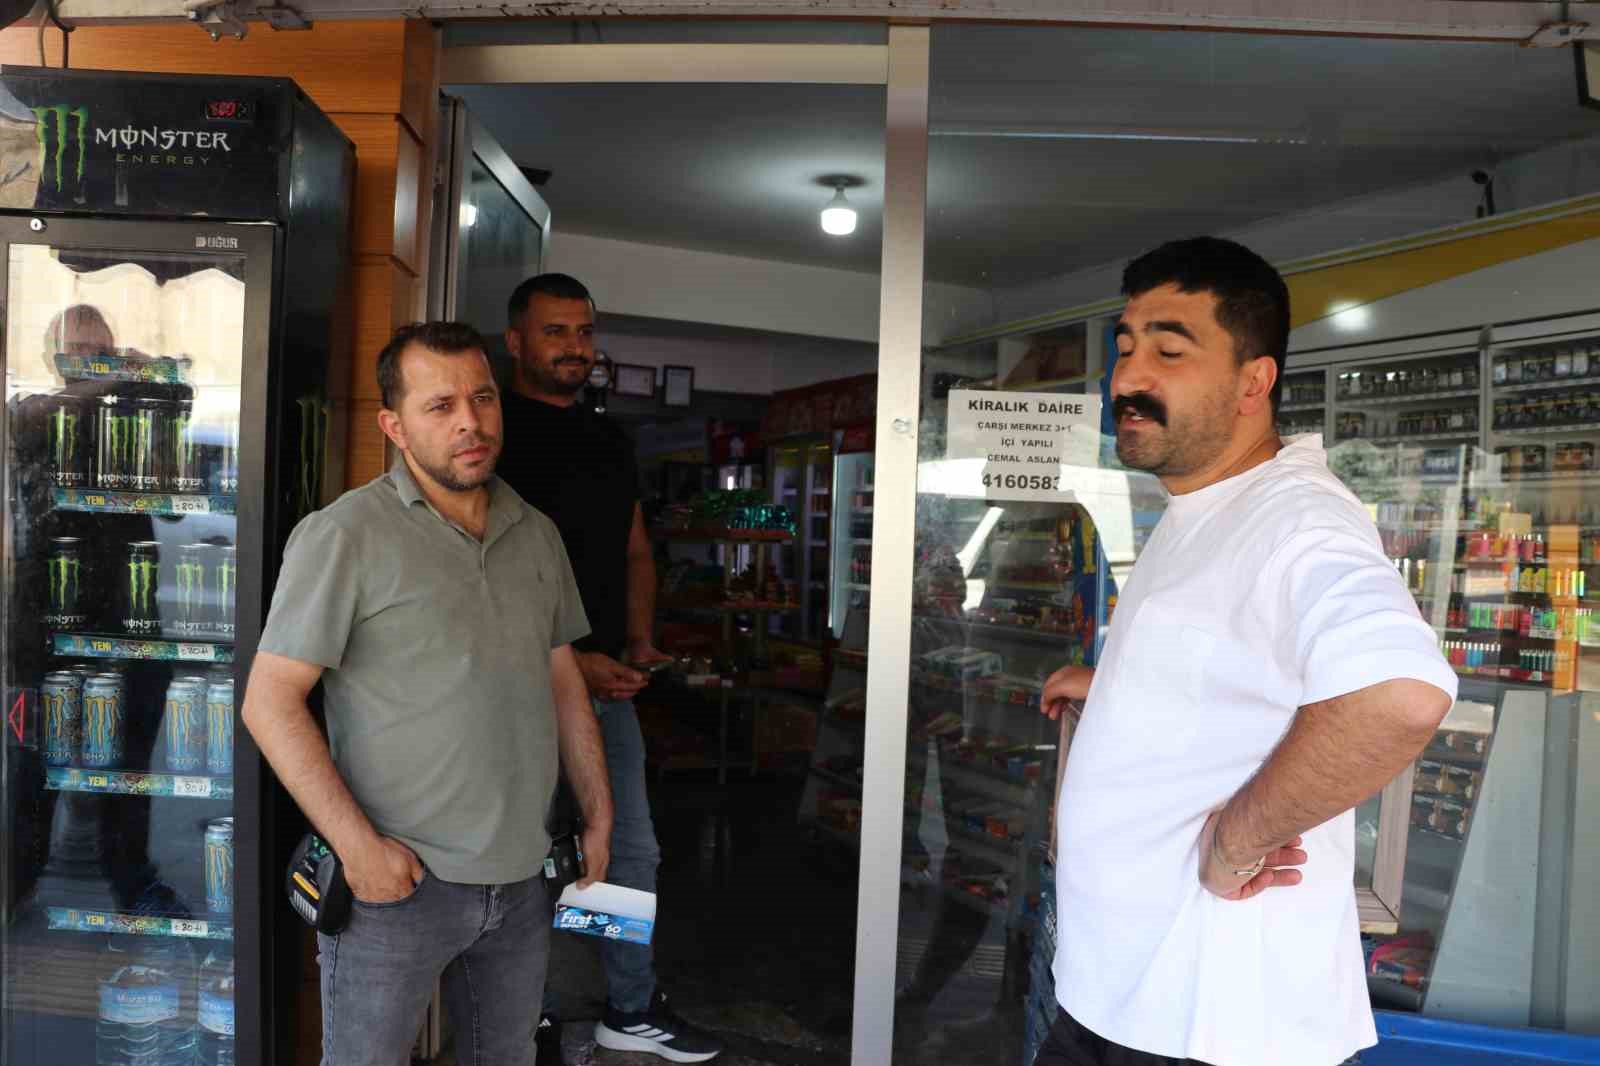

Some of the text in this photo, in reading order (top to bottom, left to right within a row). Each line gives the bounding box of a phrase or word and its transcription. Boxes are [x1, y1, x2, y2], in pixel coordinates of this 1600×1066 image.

[96, 125, 231, 151] MONSTER
[116, 153, 211, 165] ENERGY
[968, 398, 1084, 415] KİRALIK DAİRE
[977, 421, 1008, 432] ÇARŞI
[1010, 423, 1052, 432] MERKEZ
[1021, 439, 1054, 449] YAPILI
[987, 454, 1060, 465] CEMAL ASLAN
[560, 911, 592, 925] First
[604, 924, 622, 933] 60
